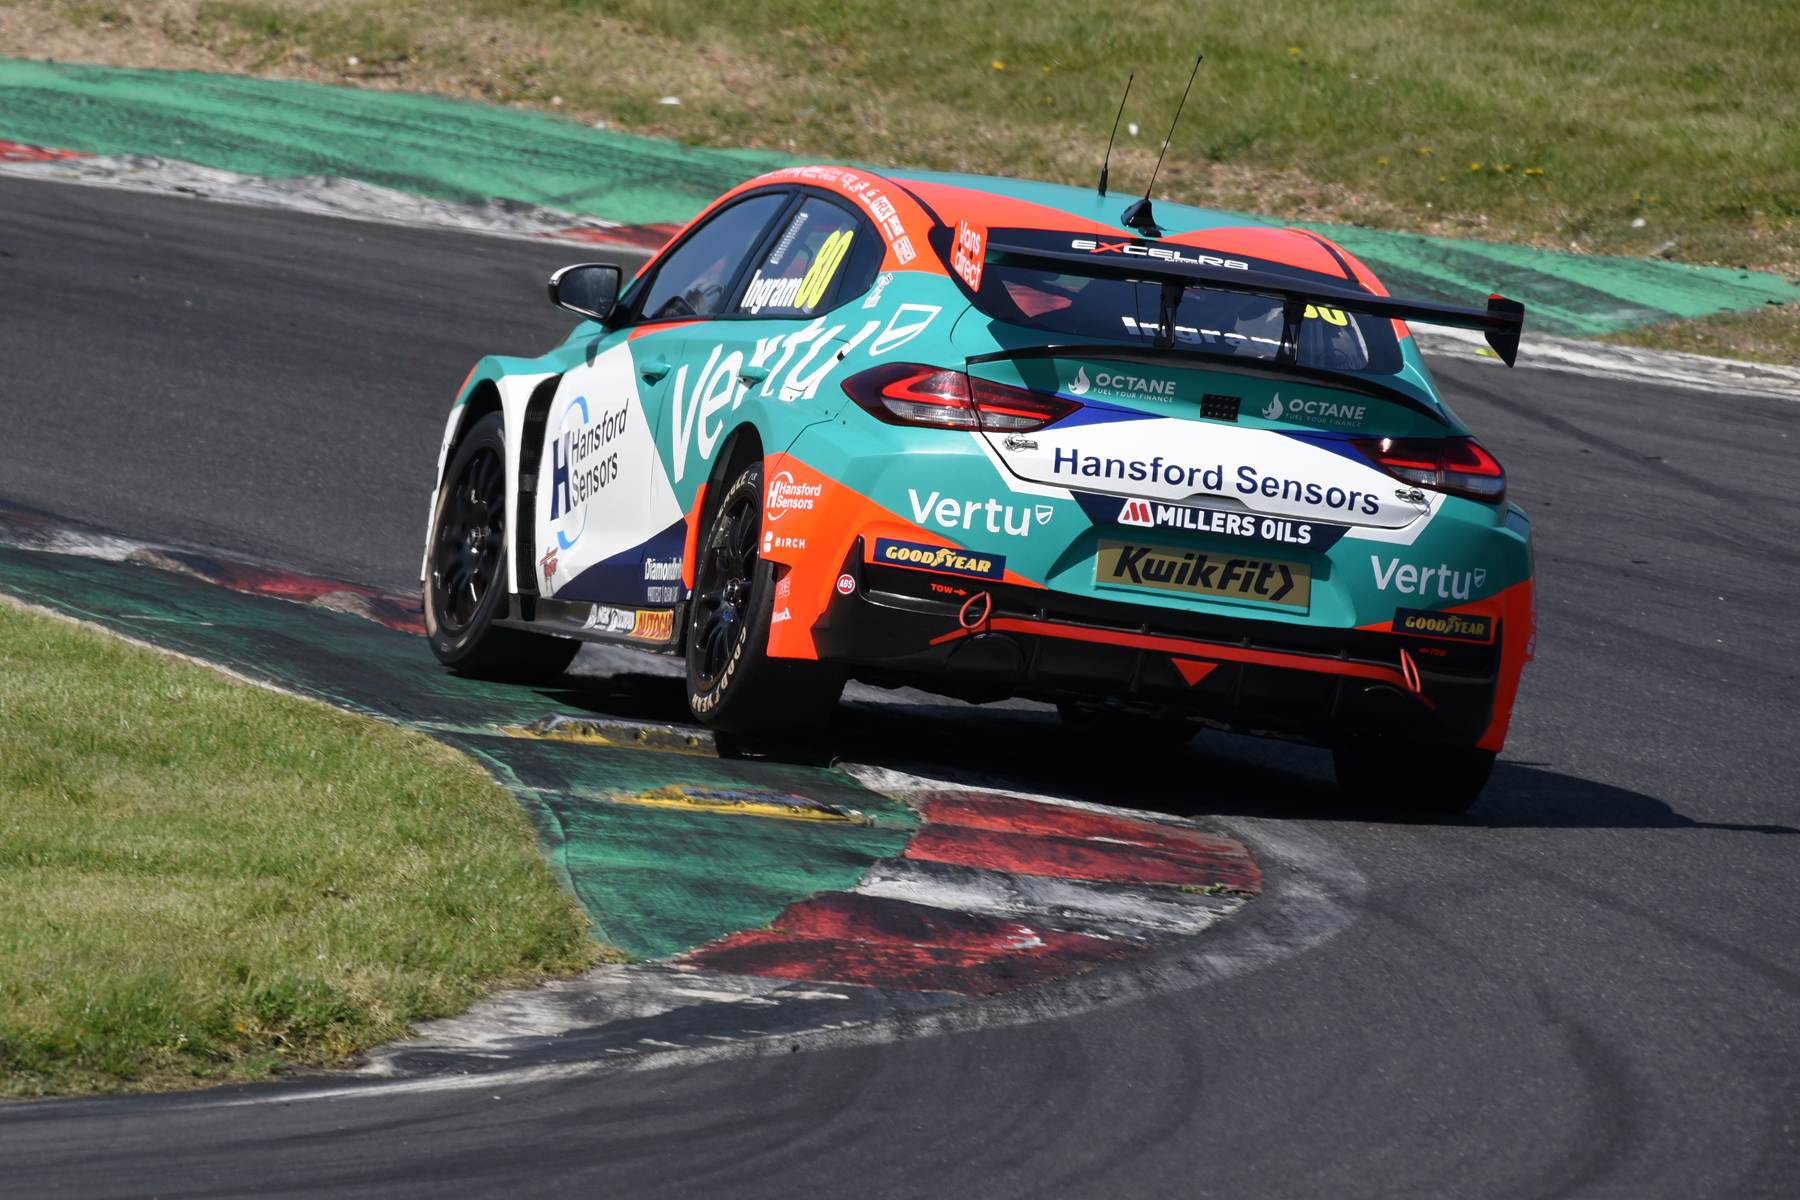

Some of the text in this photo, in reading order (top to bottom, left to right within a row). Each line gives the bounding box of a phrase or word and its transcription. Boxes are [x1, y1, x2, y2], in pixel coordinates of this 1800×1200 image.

[960, 220, 981, 255] Vans
[794, 230, 854, 308] 80
[955, 248, 980, 290] direct
[1072, 239, 1248, 270] EXCELR8
[741, 269, 802, 314] Ingram
[1093, 387, 1173, 403] FUEL YOUR FINANCE
[1095, 373, 1177, 395] OCTANE
[672, 316, 881, 484] Vertu
[1288, 398, 1367, 420] OCTANE
[572, 398, 629, 466] Hansford
[1285, 412, 1362, 428] FUEL YOUR FINANCE
[572, 452, 618, 507] Sensors
[779, 483, 822, 497] Hansford
[1053, 447, 1380, 516] Hansford Sensors
[776, 497, 813, 510] Sensors
[908, 489, 1031, 537] Vertu
[1156, 505, 1312, 544] MILLERS OILS
[775, 537, 805, 549] BIRCH
[886, 546, 991, 573] GOODYEAR
[839, 580, 853, 589] ABS
[931, 583, 953, 594] TOW
[1371, 555, 1471, 600] Vertu
[1430, 648, 1447, 657] TOW
